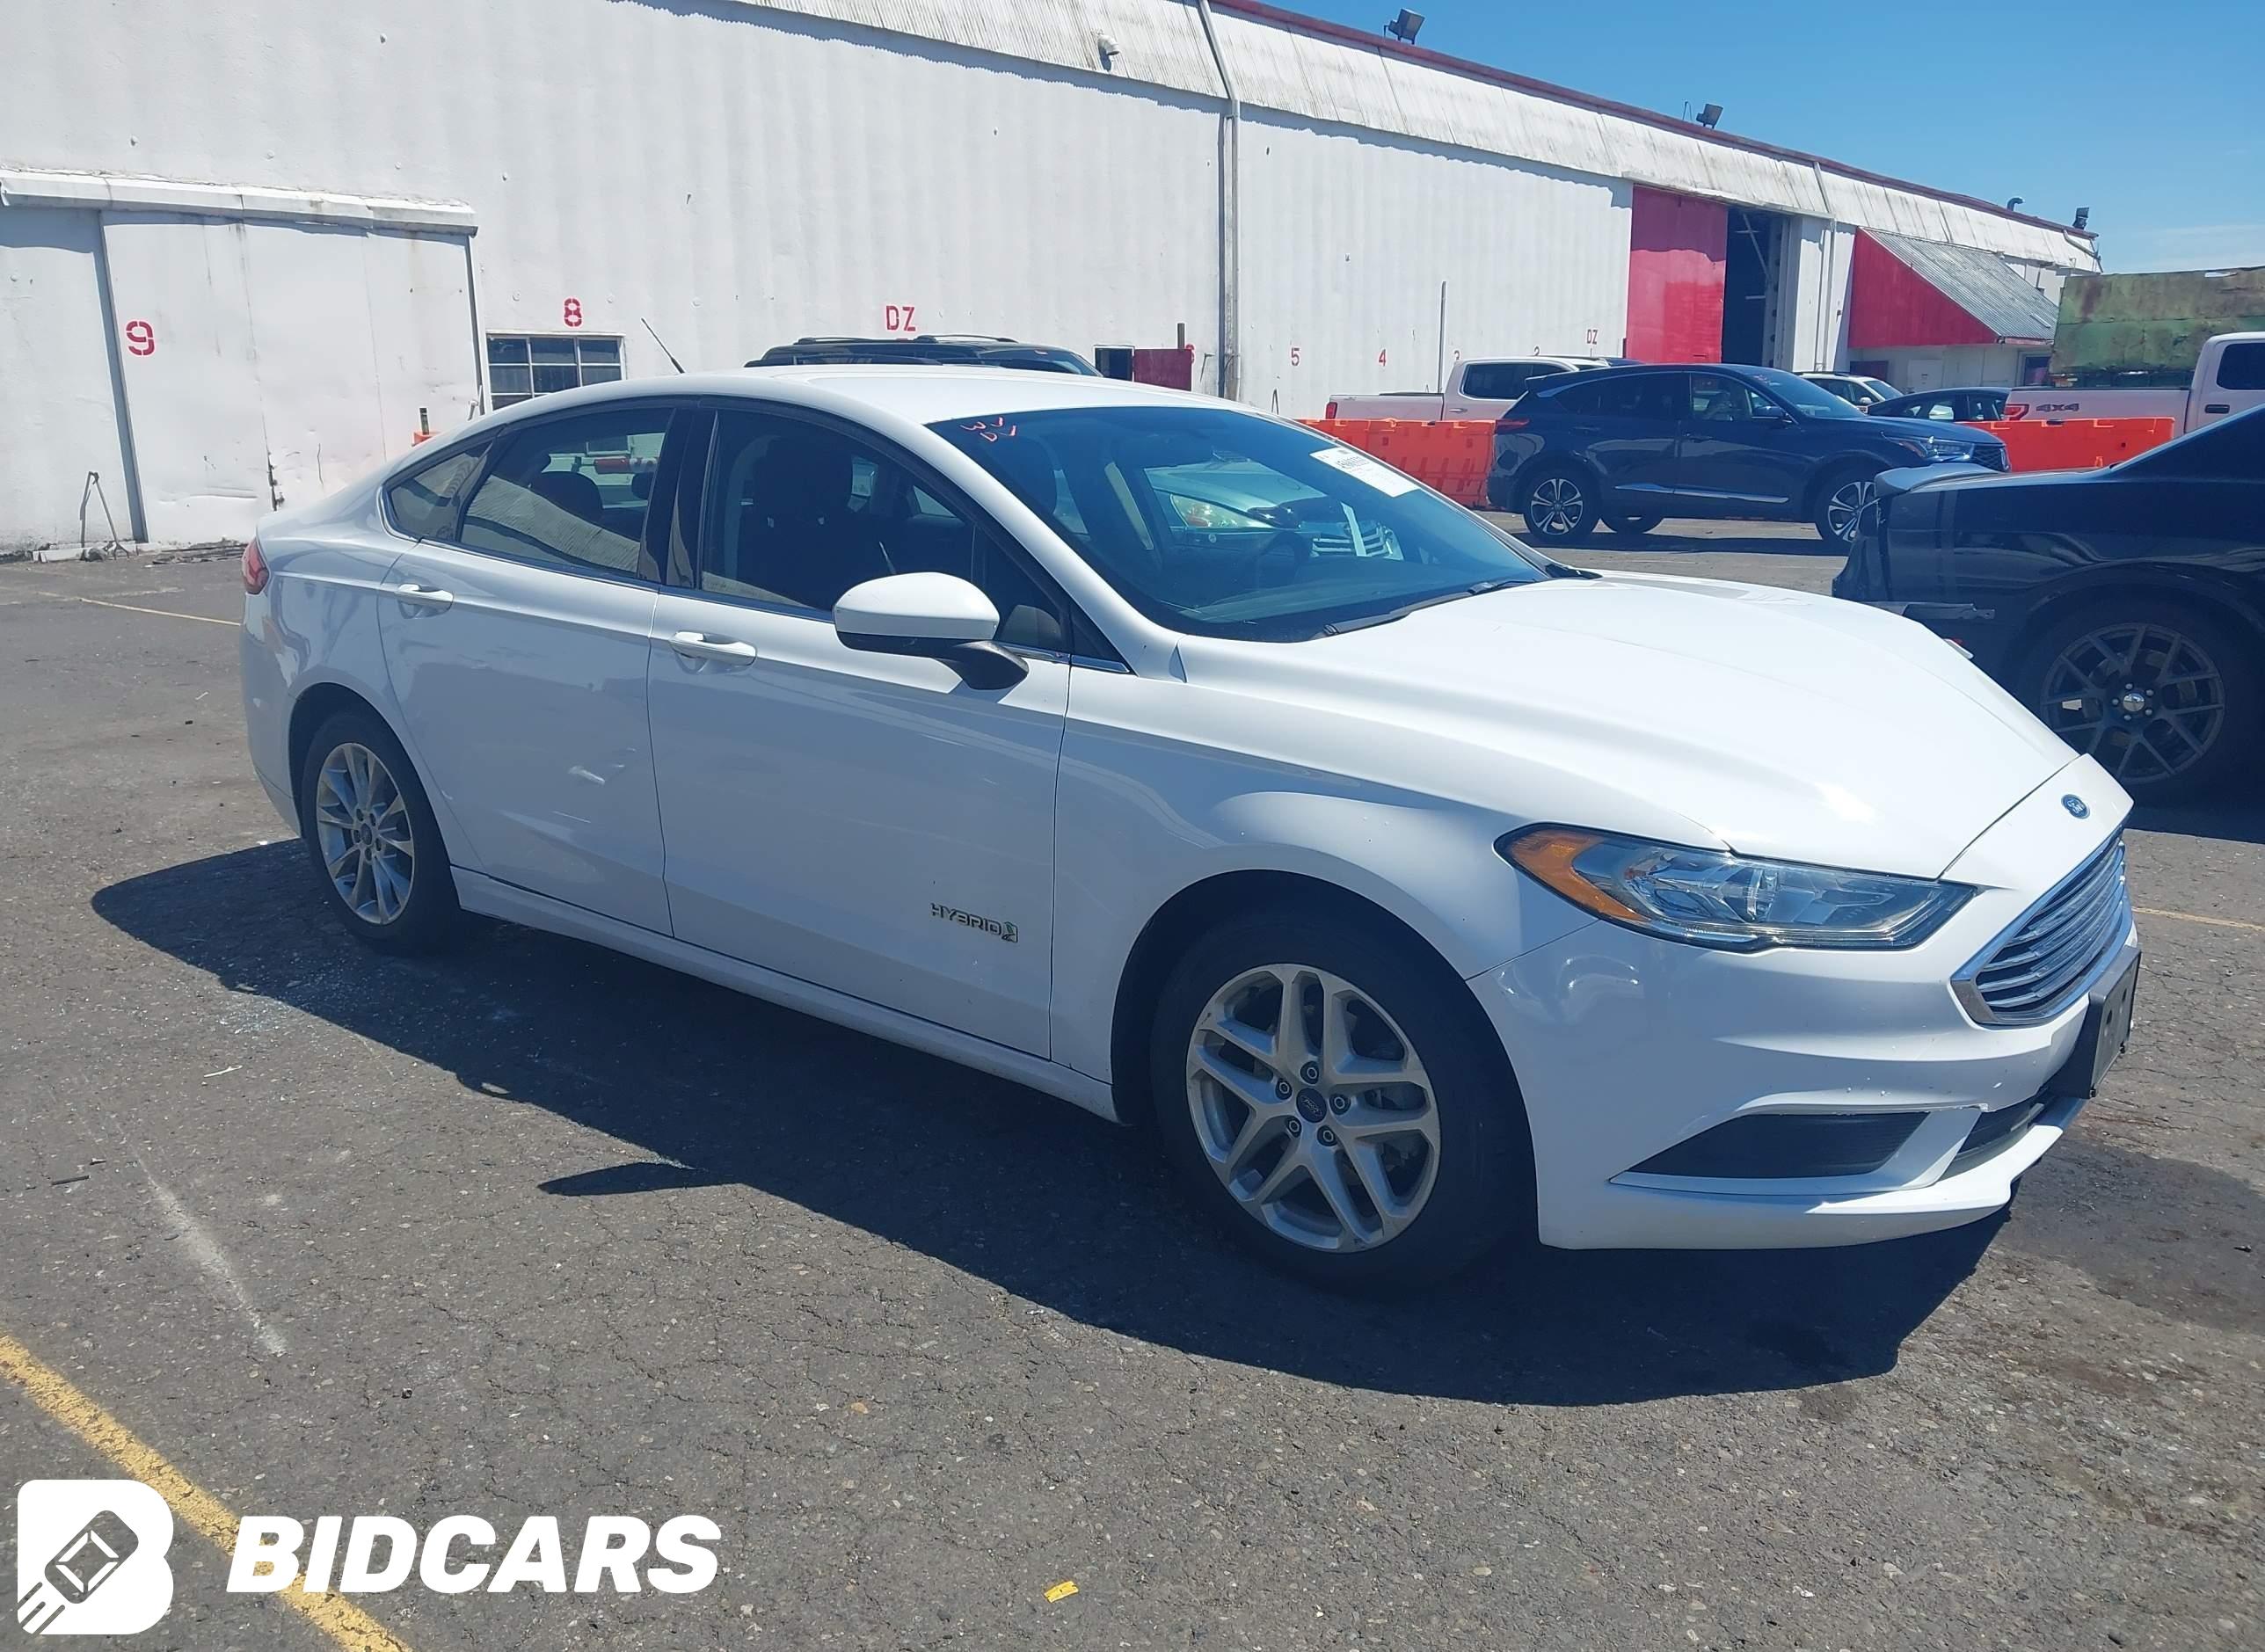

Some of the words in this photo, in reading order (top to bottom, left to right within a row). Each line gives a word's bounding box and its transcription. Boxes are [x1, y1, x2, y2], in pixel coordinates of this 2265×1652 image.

[564, 298, 582, 327] 8
[885, 305, 916, 331] DZ
[126, 321, 155, 356] 9
[1291, 347, 1300, 366] 5
[1378, 348, 1387, 367] 4
[930, 902, 1002, 935] HYBRID
